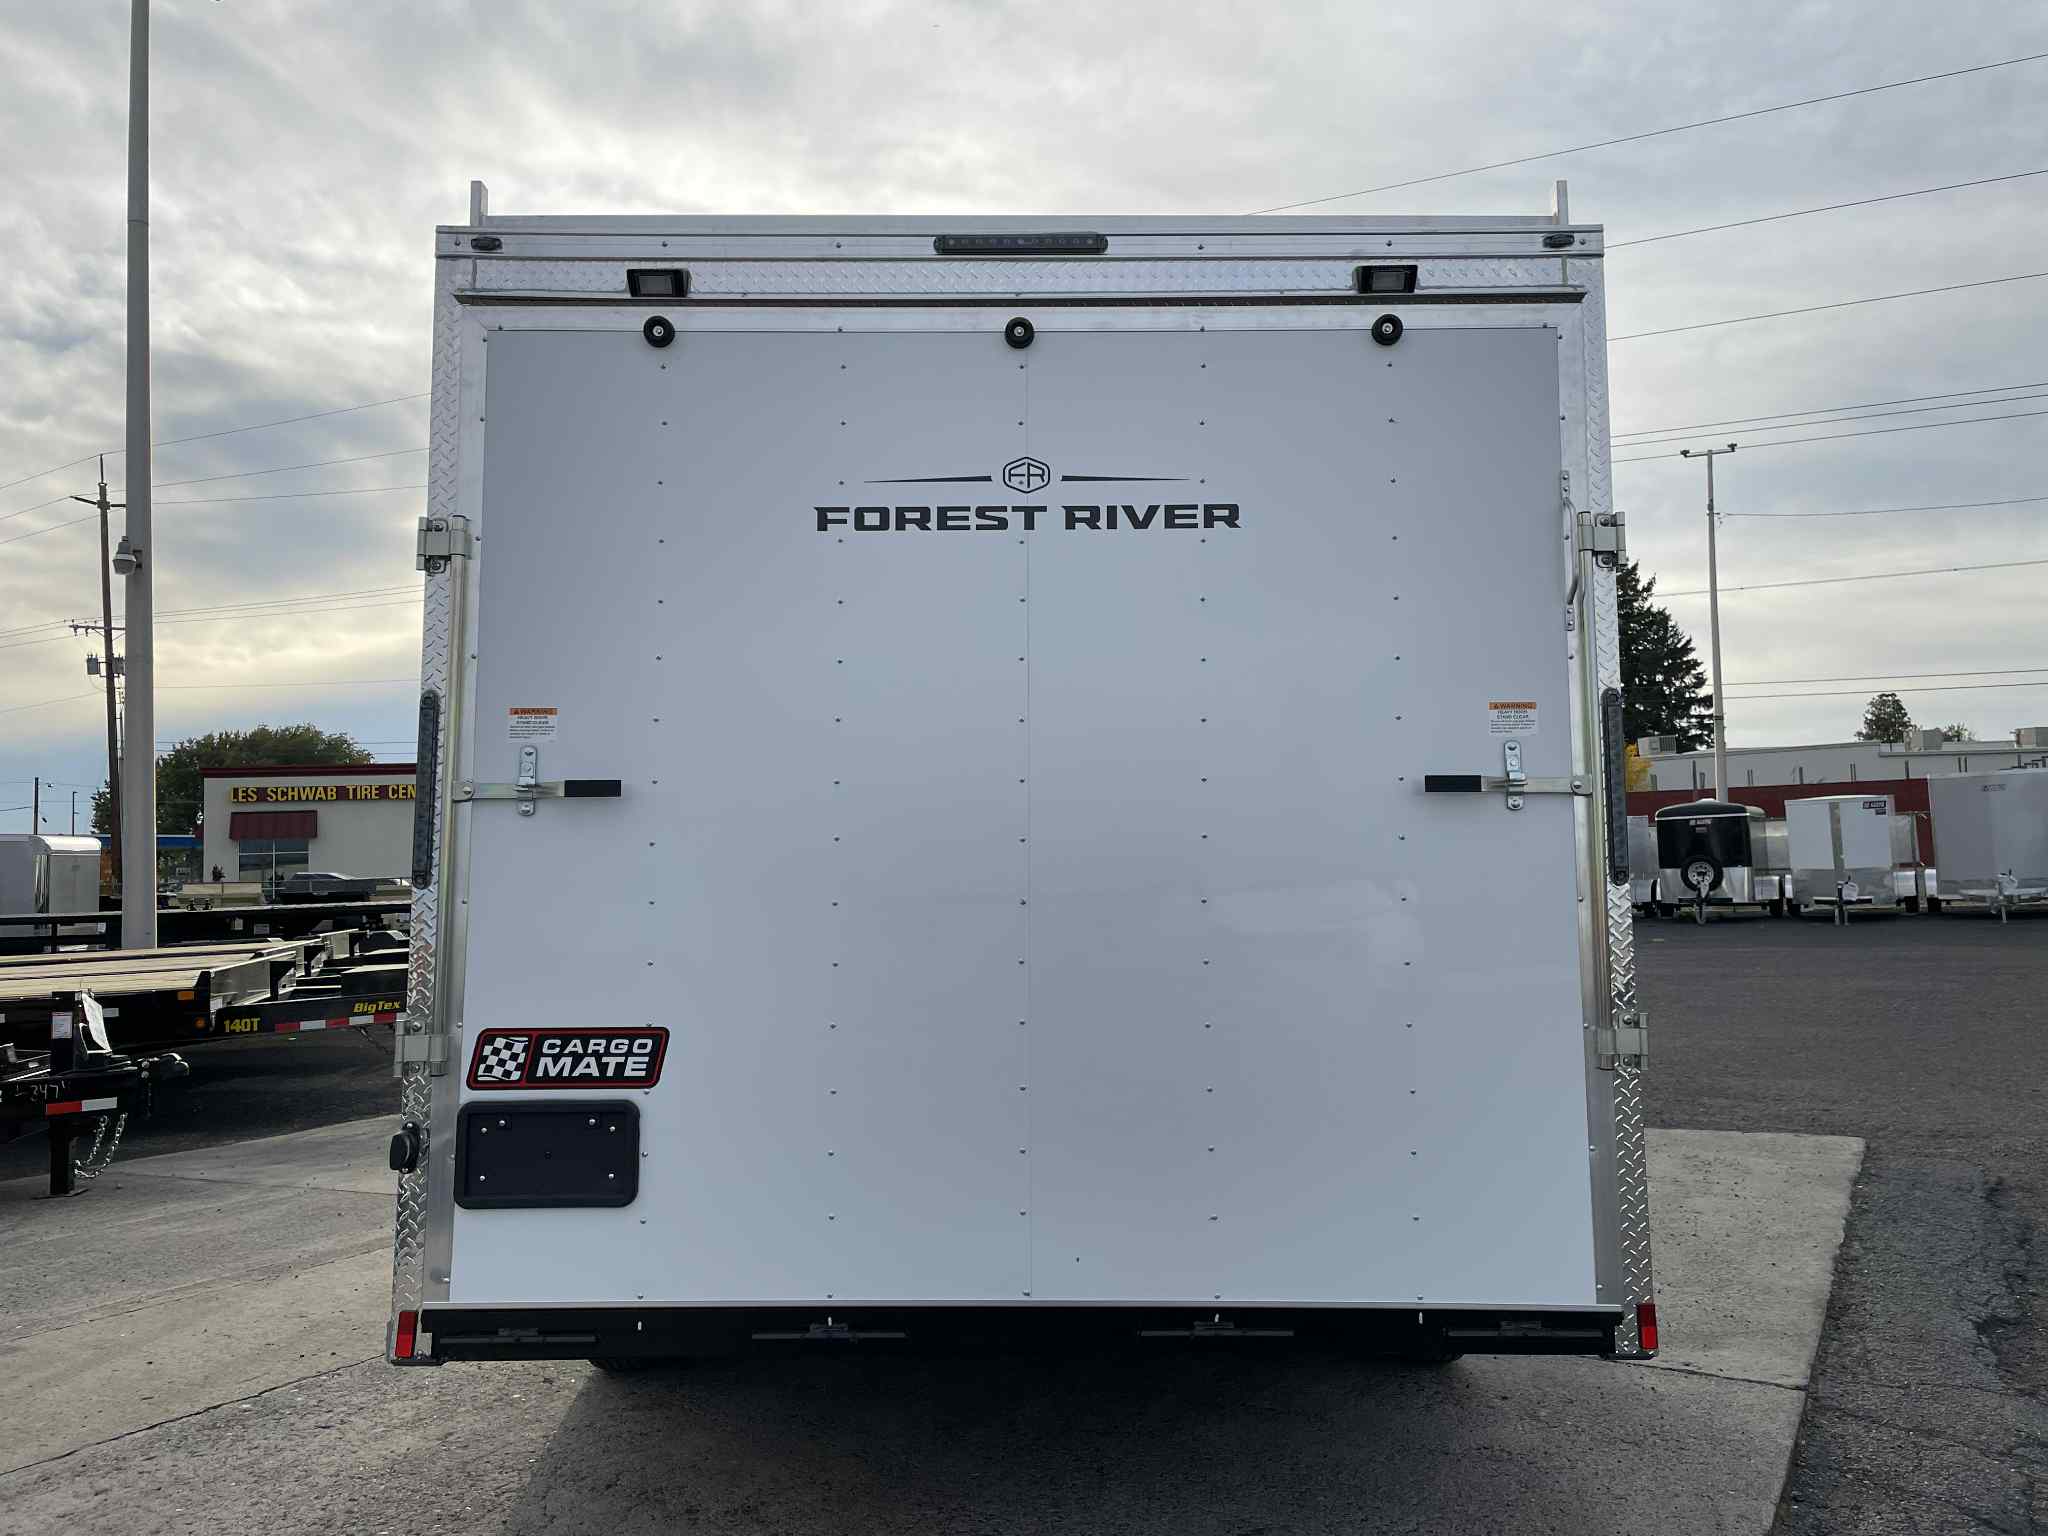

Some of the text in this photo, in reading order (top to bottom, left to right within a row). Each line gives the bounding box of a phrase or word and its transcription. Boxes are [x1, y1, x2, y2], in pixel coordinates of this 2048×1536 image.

[813, 503, 1241, 532] FOREST RIVER
[231, 786, 258, 802] LES
[266, 785, 337, 802] SCHWAB
[345, 784, 381, 801] TIRE
[223, 1017, 261, 1034] 140T
[542, 1038, 653, 1054] CARGO
[535, 1056, 650, 1077] MATE
